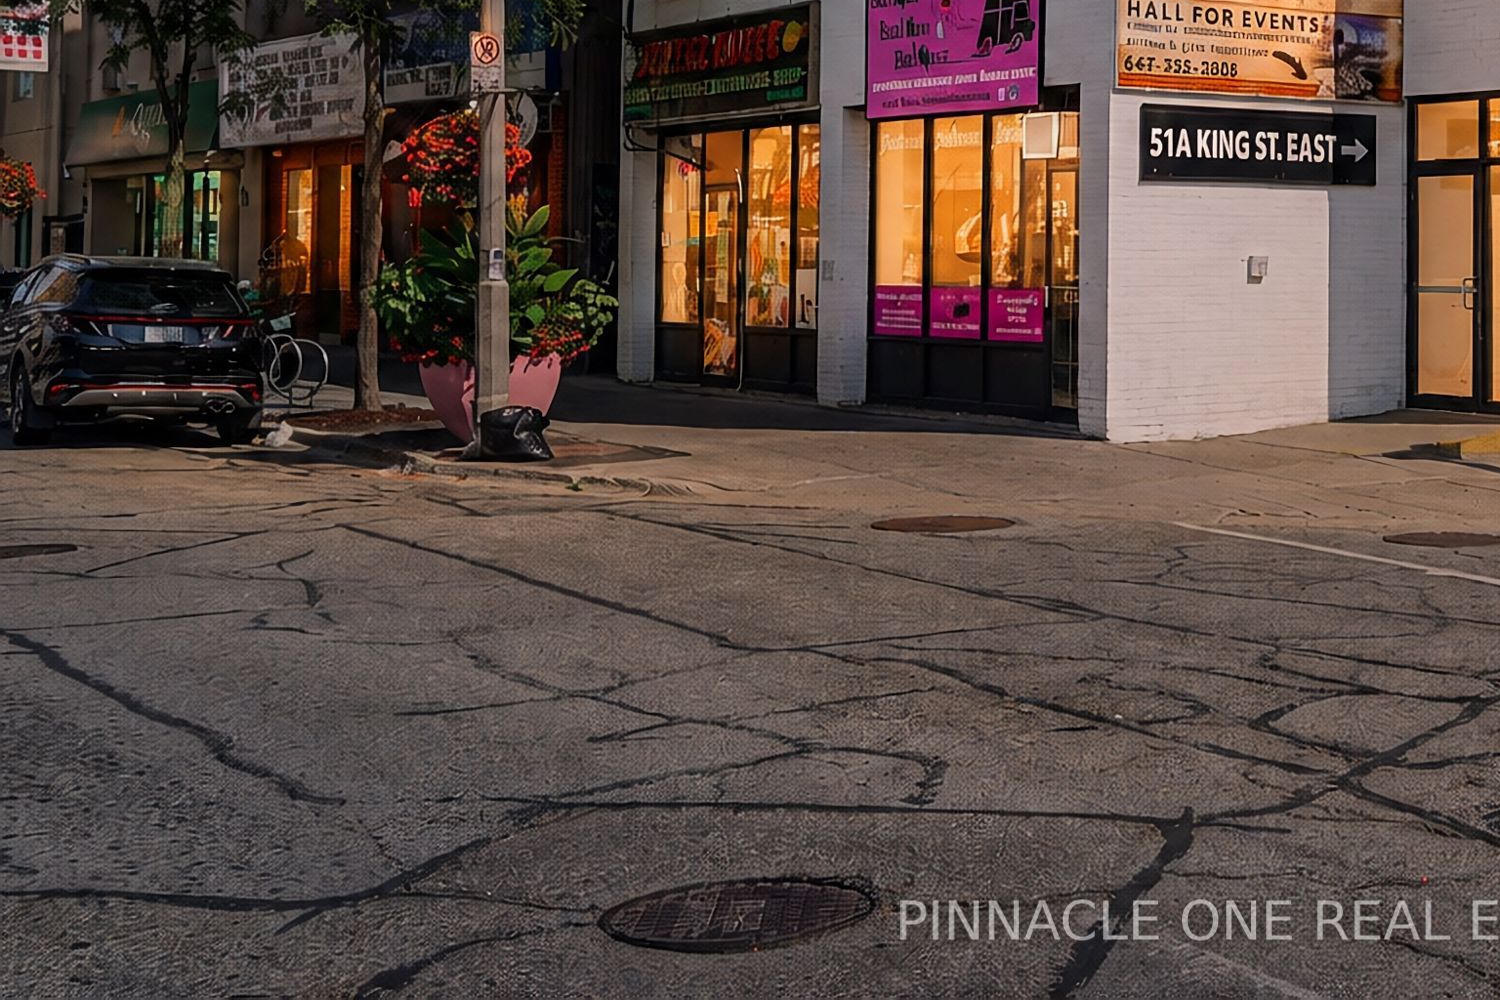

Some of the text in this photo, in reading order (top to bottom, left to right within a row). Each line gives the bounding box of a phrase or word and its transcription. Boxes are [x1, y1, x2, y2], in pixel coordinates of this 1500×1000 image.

[1127, 0, 1184, 22] HALL
[1192, 6, 1234, 27] FOR
[1242, 10, 1319, 33] EVENTS
[1150, 127, 1337, 163] 51A KING ST. EAST
